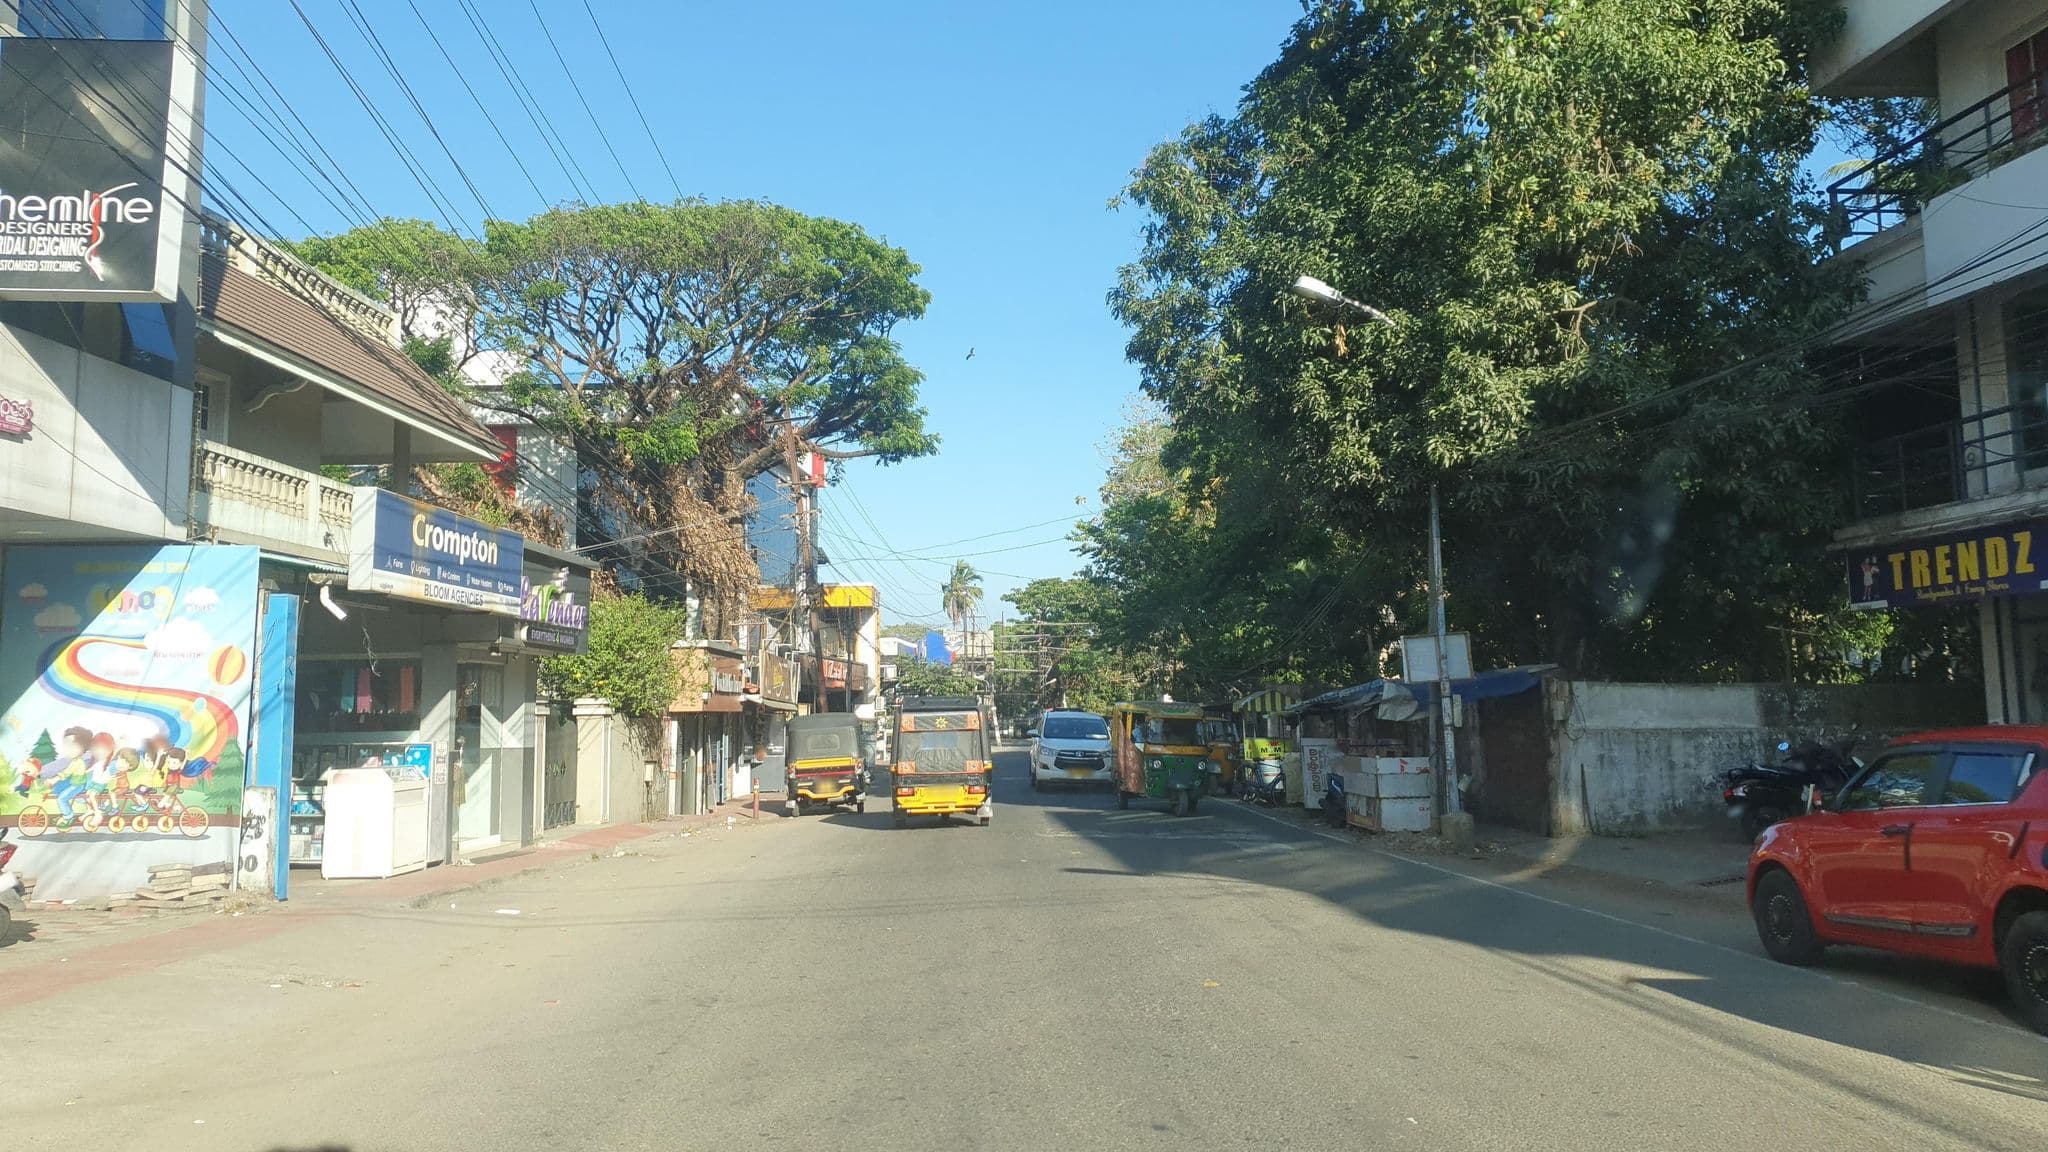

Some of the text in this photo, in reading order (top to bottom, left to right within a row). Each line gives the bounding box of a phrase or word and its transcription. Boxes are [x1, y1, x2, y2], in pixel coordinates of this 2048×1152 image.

[28, 237, 88, 257] DESIGNING
[39, 260, 82, 273] STITCHING
[412, 513, 498, 566] Crompton
[1888, 531, 2034, 590] TRENDZ
[424, 583, 450, 601] BLOOM
[451, 588, 484, 607] AGENCIES
